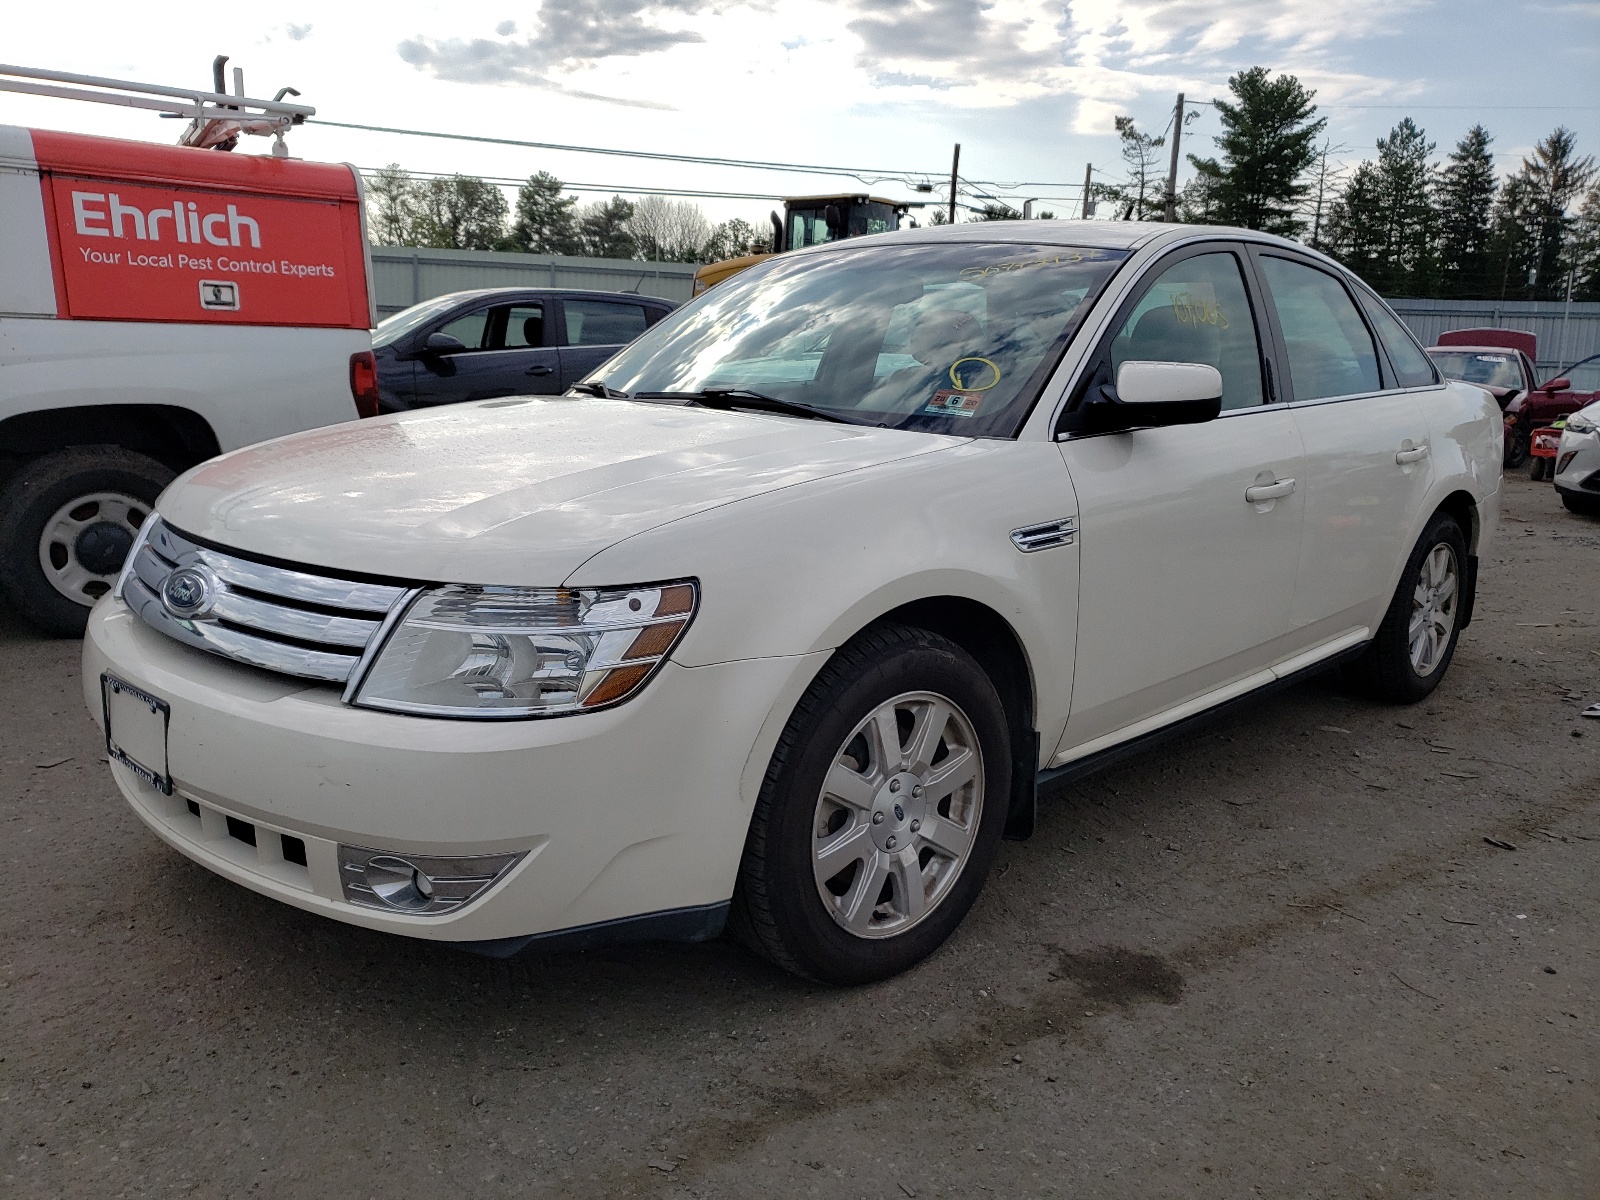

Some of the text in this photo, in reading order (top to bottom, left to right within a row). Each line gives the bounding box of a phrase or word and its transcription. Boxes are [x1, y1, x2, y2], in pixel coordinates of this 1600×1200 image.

[72, 191, 261, 248] Ehrlich
[79, 246, 335, 278] Your Local Pest Control Experts
[952, 397, 960, 405] 6
[168, 576, 196, 602] Ford
